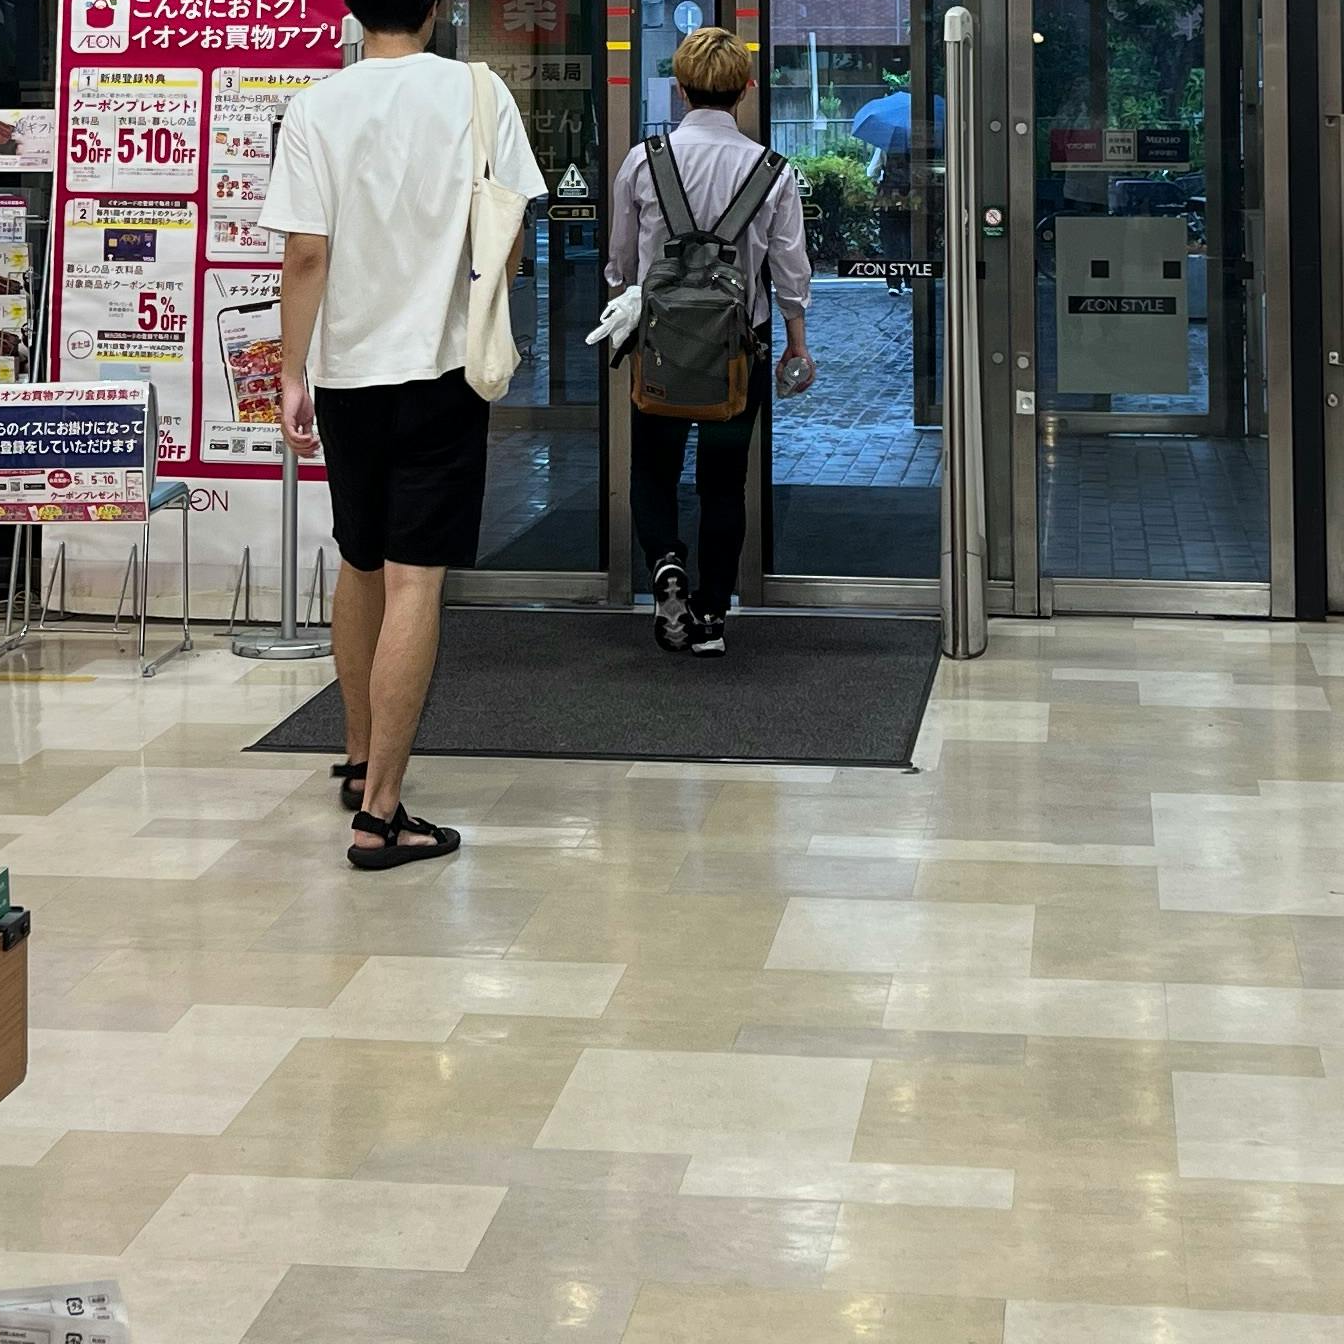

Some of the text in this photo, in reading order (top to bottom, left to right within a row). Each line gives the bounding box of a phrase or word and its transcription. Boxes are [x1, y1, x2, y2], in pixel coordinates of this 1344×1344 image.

[131, 24, 343, 50] イオンお買物アプリ
[100, 73, 167, 85] 新規登録特典
[490, 63, 582, 82] オン薬局
[73, 99, 197, 113] クーポンプレゼント!
[71, 116, 99, 126] 食料品
[15, 120, 54, 136] 夏ギフト
[1108, 146, 1132, 155] ATM
[889, 263, 932, 276] STYLE
[1121, 299, 1165, 312] STYLE
